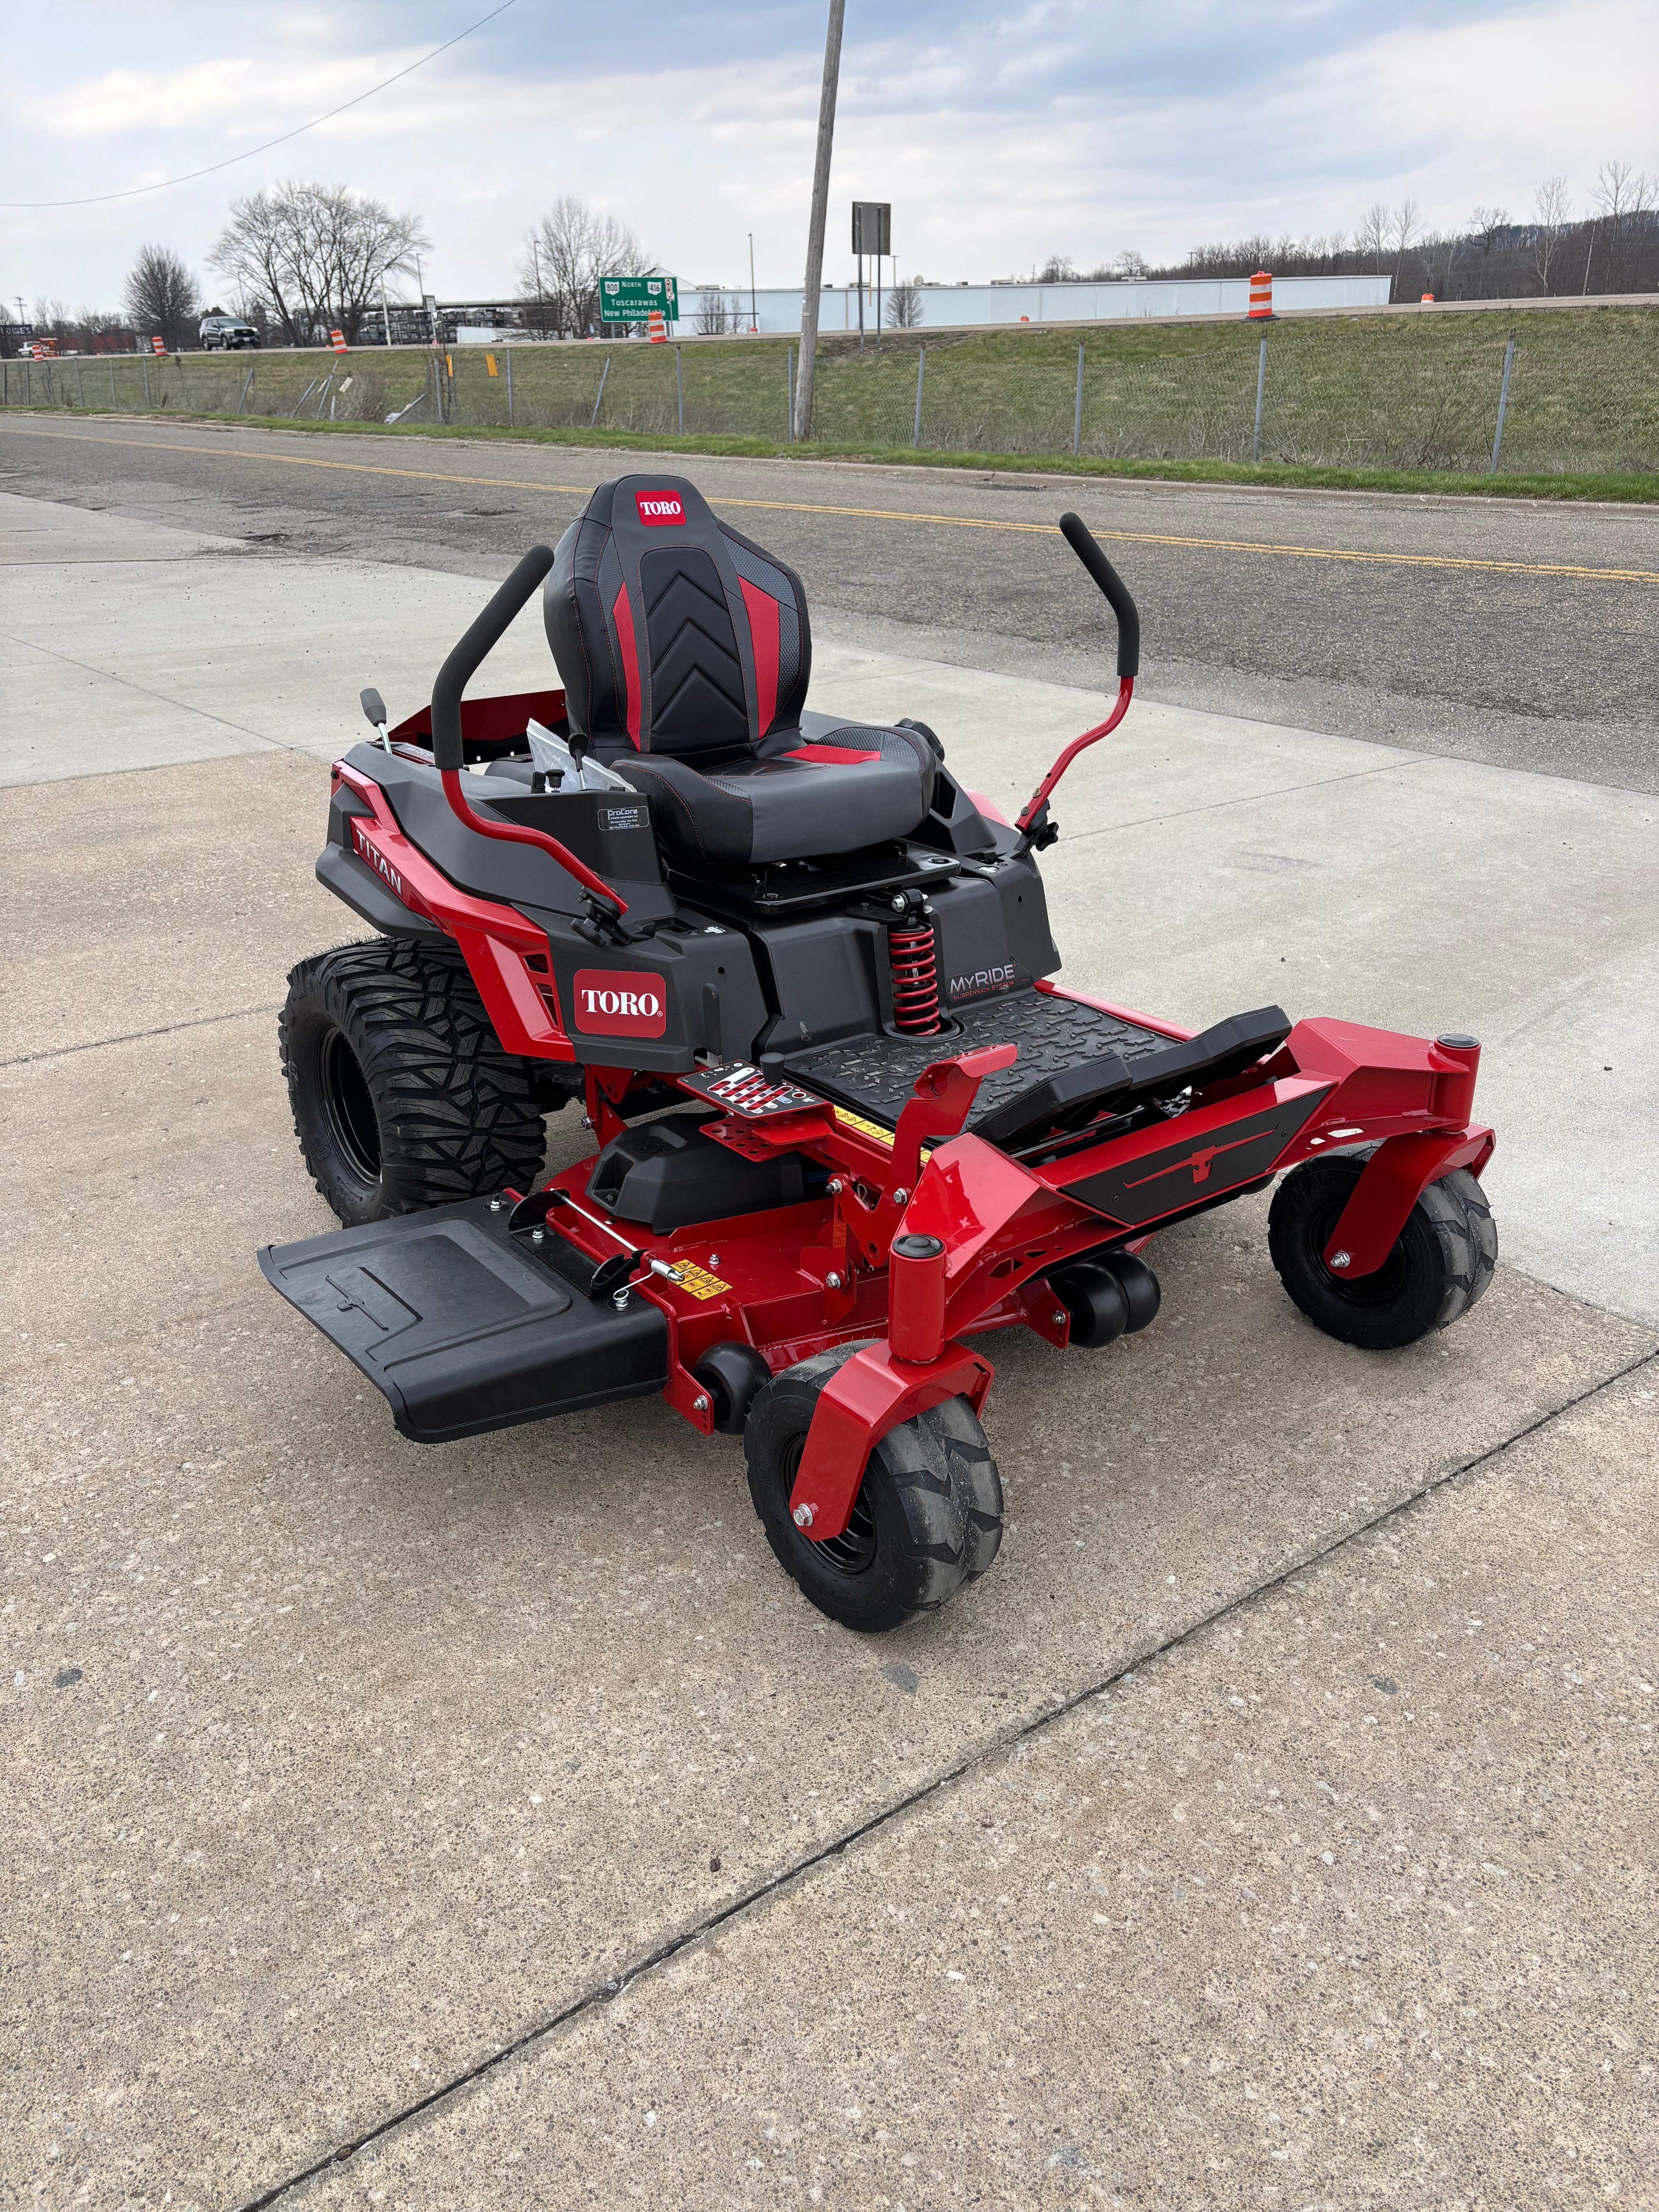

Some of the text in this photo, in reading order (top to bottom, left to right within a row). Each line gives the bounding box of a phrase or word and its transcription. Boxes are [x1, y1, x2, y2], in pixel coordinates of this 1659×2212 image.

[640, 501, 681, 515] TORO
[607, 809, 638, 820] ProCore
[356, 828, 402, 897] TITAN
[953, 981, 1014, 1000] SUSPENSION SYSTEM
